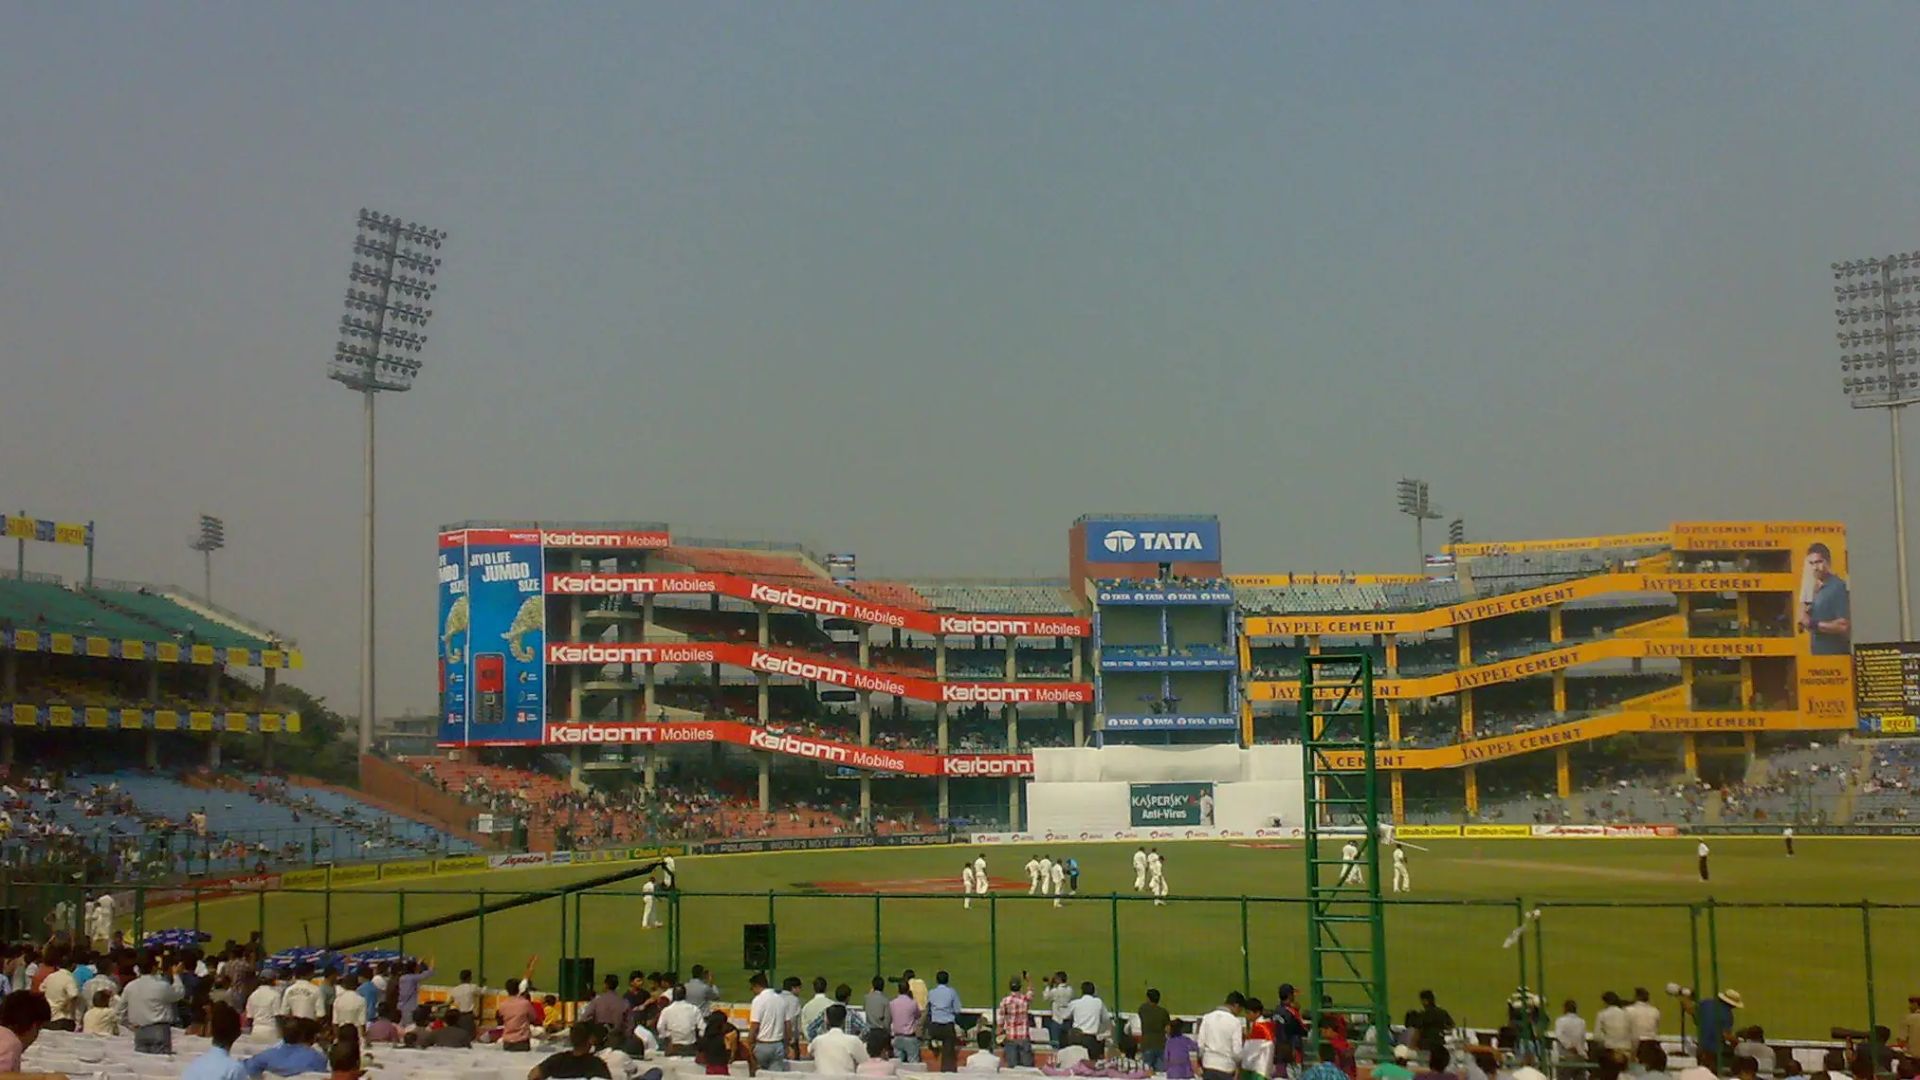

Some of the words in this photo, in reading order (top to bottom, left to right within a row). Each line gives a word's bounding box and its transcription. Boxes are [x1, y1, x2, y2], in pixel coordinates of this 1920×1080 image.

[544, 532, 621, 546] Karbonn
[627, 535, 668, 547] Mobiles
[1140, 532, 1203, 550] TATA
[492, 551, 511, 564] LIFE
[482, 561, 530, 583] JUMBO
[518, 578, 540, 592] SIZE
[553, 575, 655, 592] Karbonn
[662, 577, 716, 592] Mobiles
[1700, 579, 1761, 588] CEMENT
[751, 583, 849, 615] Karbonn
[854, 606, 904, 626] Mobiles
[1510, 588, 1574, 609] CEMENT
[941, 617, 1027, 634] Karbonn
[1034, 623, 1081, 635] Mobiles
[1328, 621, 1396, 632] CEMENT
[551, 645, 653, 662] Karbonn
[661, 648, 714, 662] Mobiles
[1703, 644, 1763, 653] CEMENT
[1515, 653, 1579, 675] CEMENT
[751, 651, 849, 684] Karbonn
[855, 674, 905, 695] Mobiles
[943, 685, 1029, 701] Karbonn
[1036, 689, 1082, 701] Mobiles
[1706, 717, 1765, 727] CEMENT
[550, 726, 653, 742] Karbonn
[661, 727, 714, 742] Mobiles
[1519, 728, 1582, 749] CEMENT
[750, 729, 848, 761] Karbonn
[853, 751, 904, 770] Mobiles
[944, 757, 1033, 773] Karbonn
[1132, 794, 1188, 808] KASPERSKY
[1142, 810, 1187, 819] Anti-Virus
